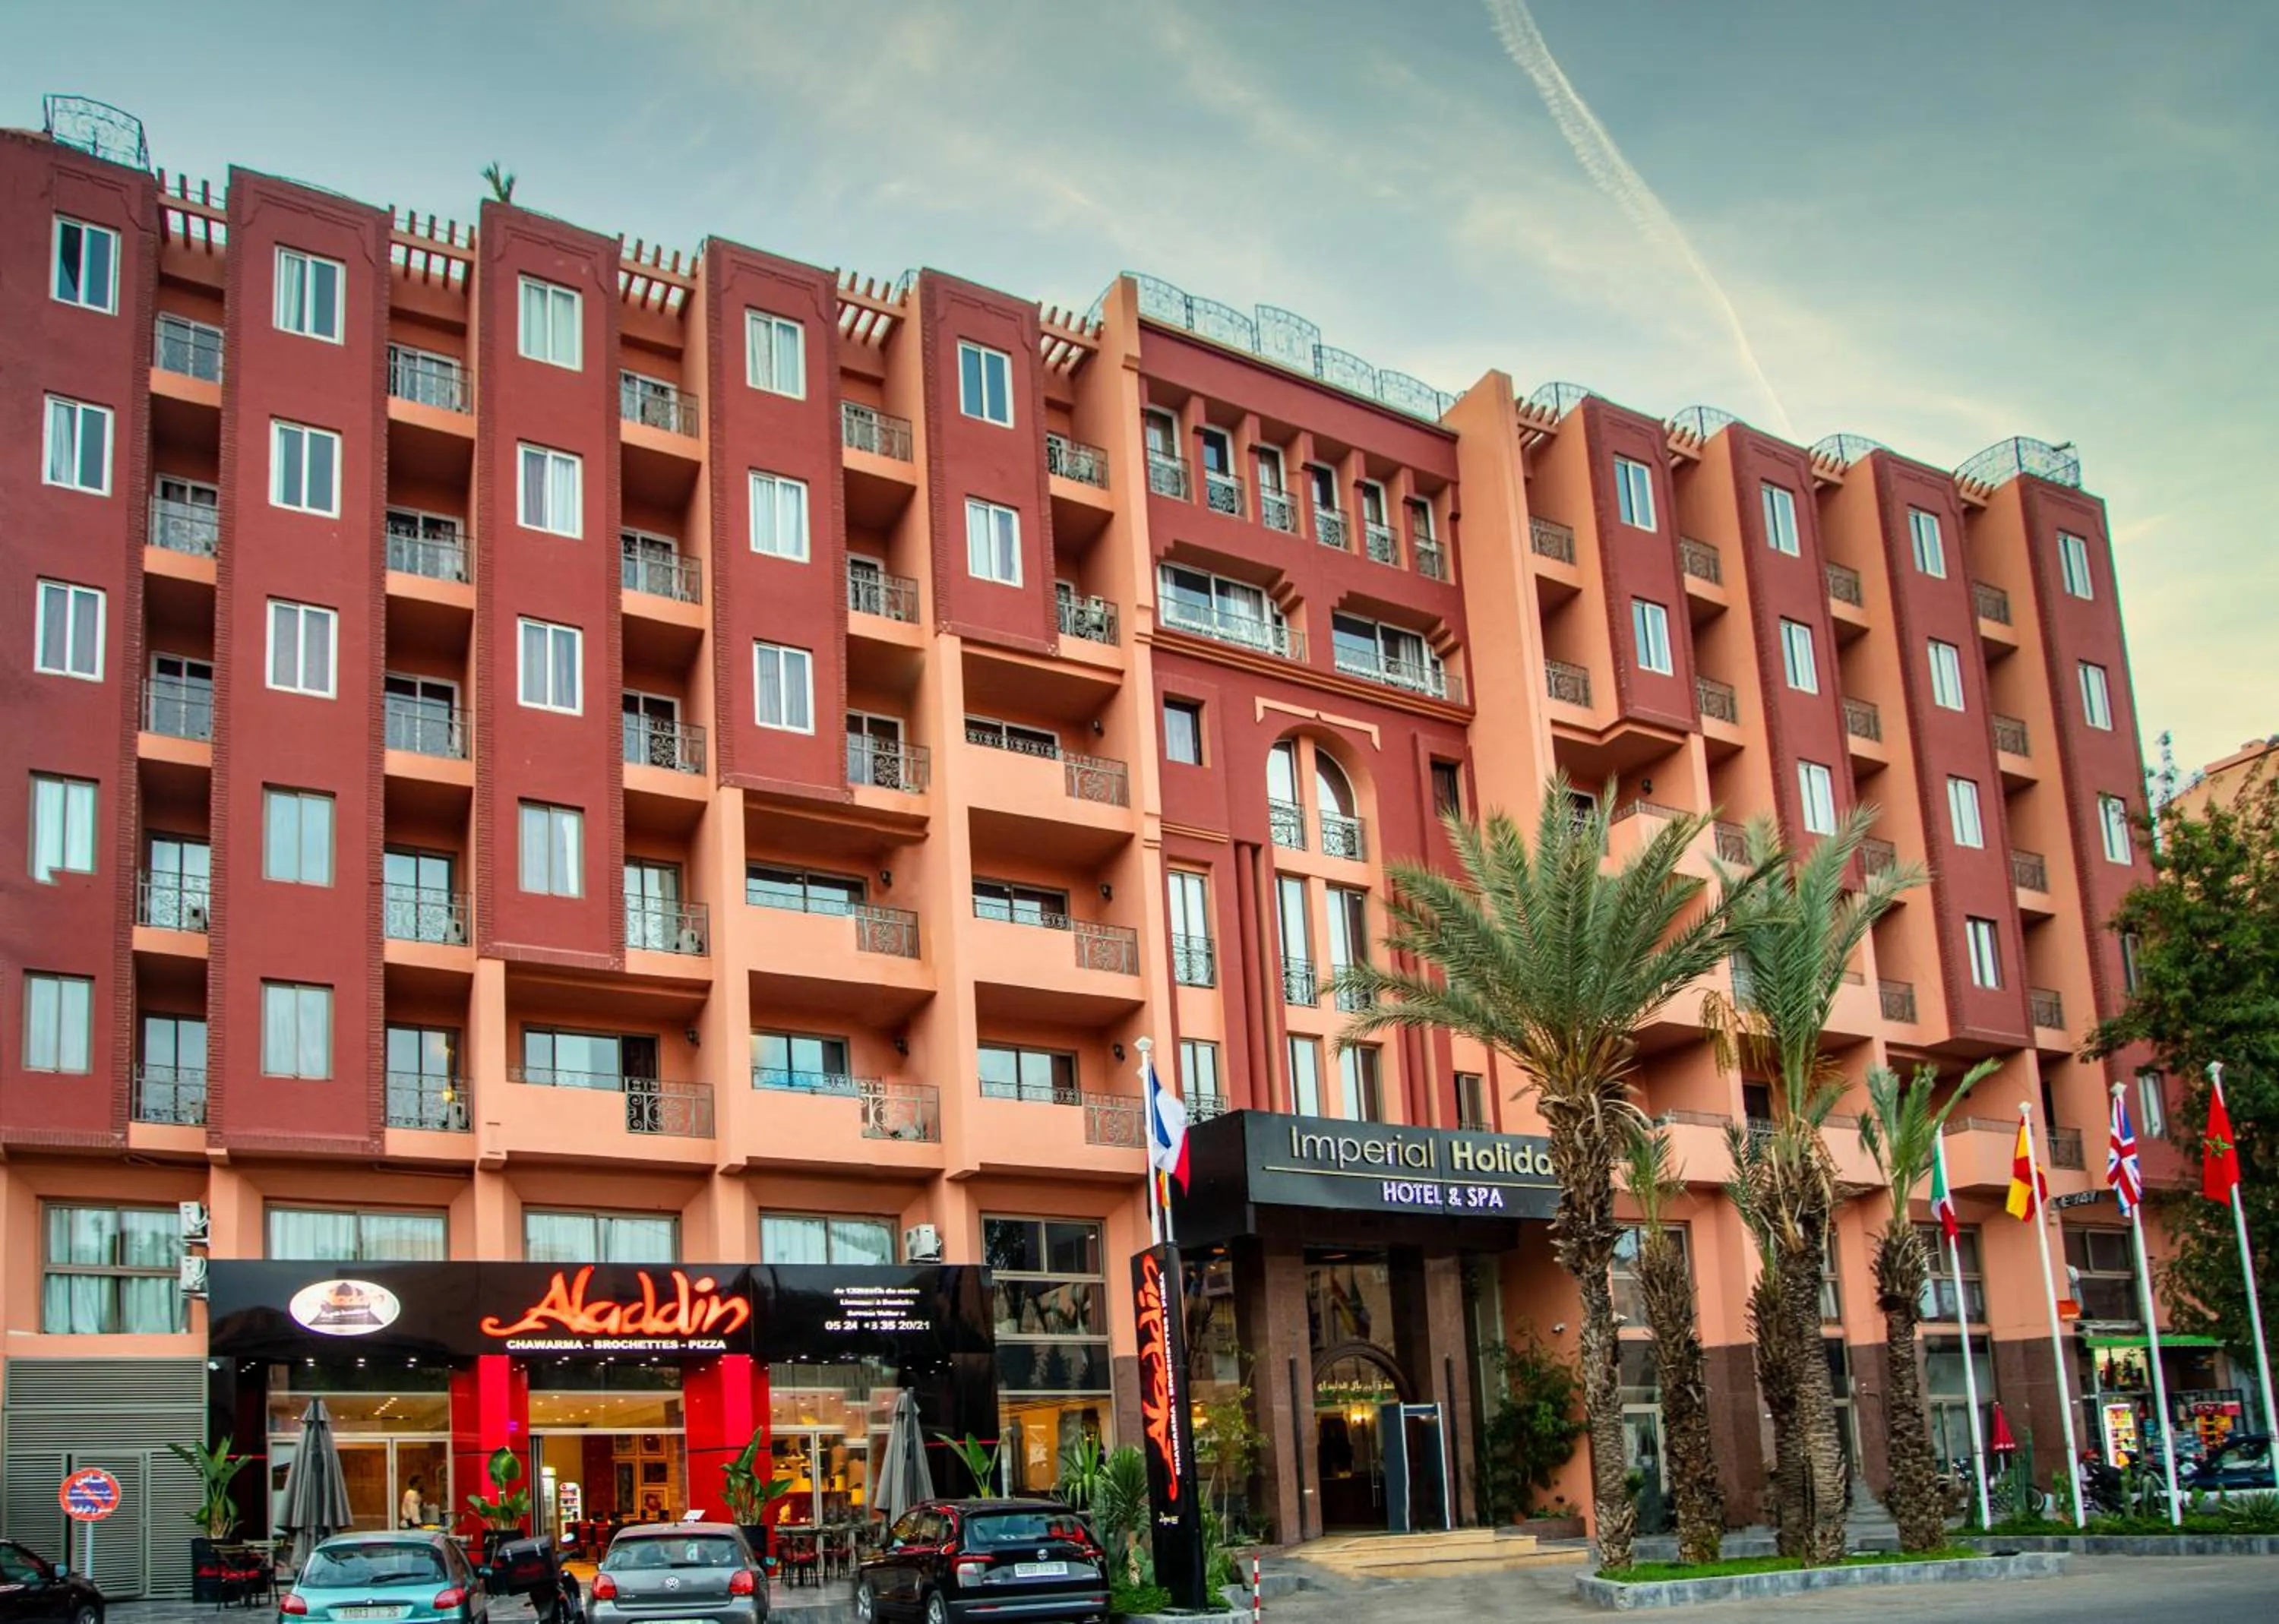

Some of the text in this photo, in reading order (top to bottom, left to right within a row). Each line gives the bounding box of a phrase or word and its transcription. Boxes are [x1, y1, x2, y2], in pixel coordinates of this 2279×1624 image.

[1290, 1124, 1554, 1175] Imperial Holida
[1383, 1181, 1503, 1208] HOTEL & SPA
[481, 1264, 751, 1335] Aladdin
[506, 1339, 584, 1350] CHAWARMA
[593, 1339, 678, 1350] BROCHETTES
[688, 1339, 726, 1350] PIZZA
[825, 1320, 842, 1331] 05
[842, 1320, 858, 1331] 24
[880, 1320, 896, 1331] 35
[897, 1320, 931, 1331] 20/21
[1137, 1253, 1177, 1502] Aladdin
